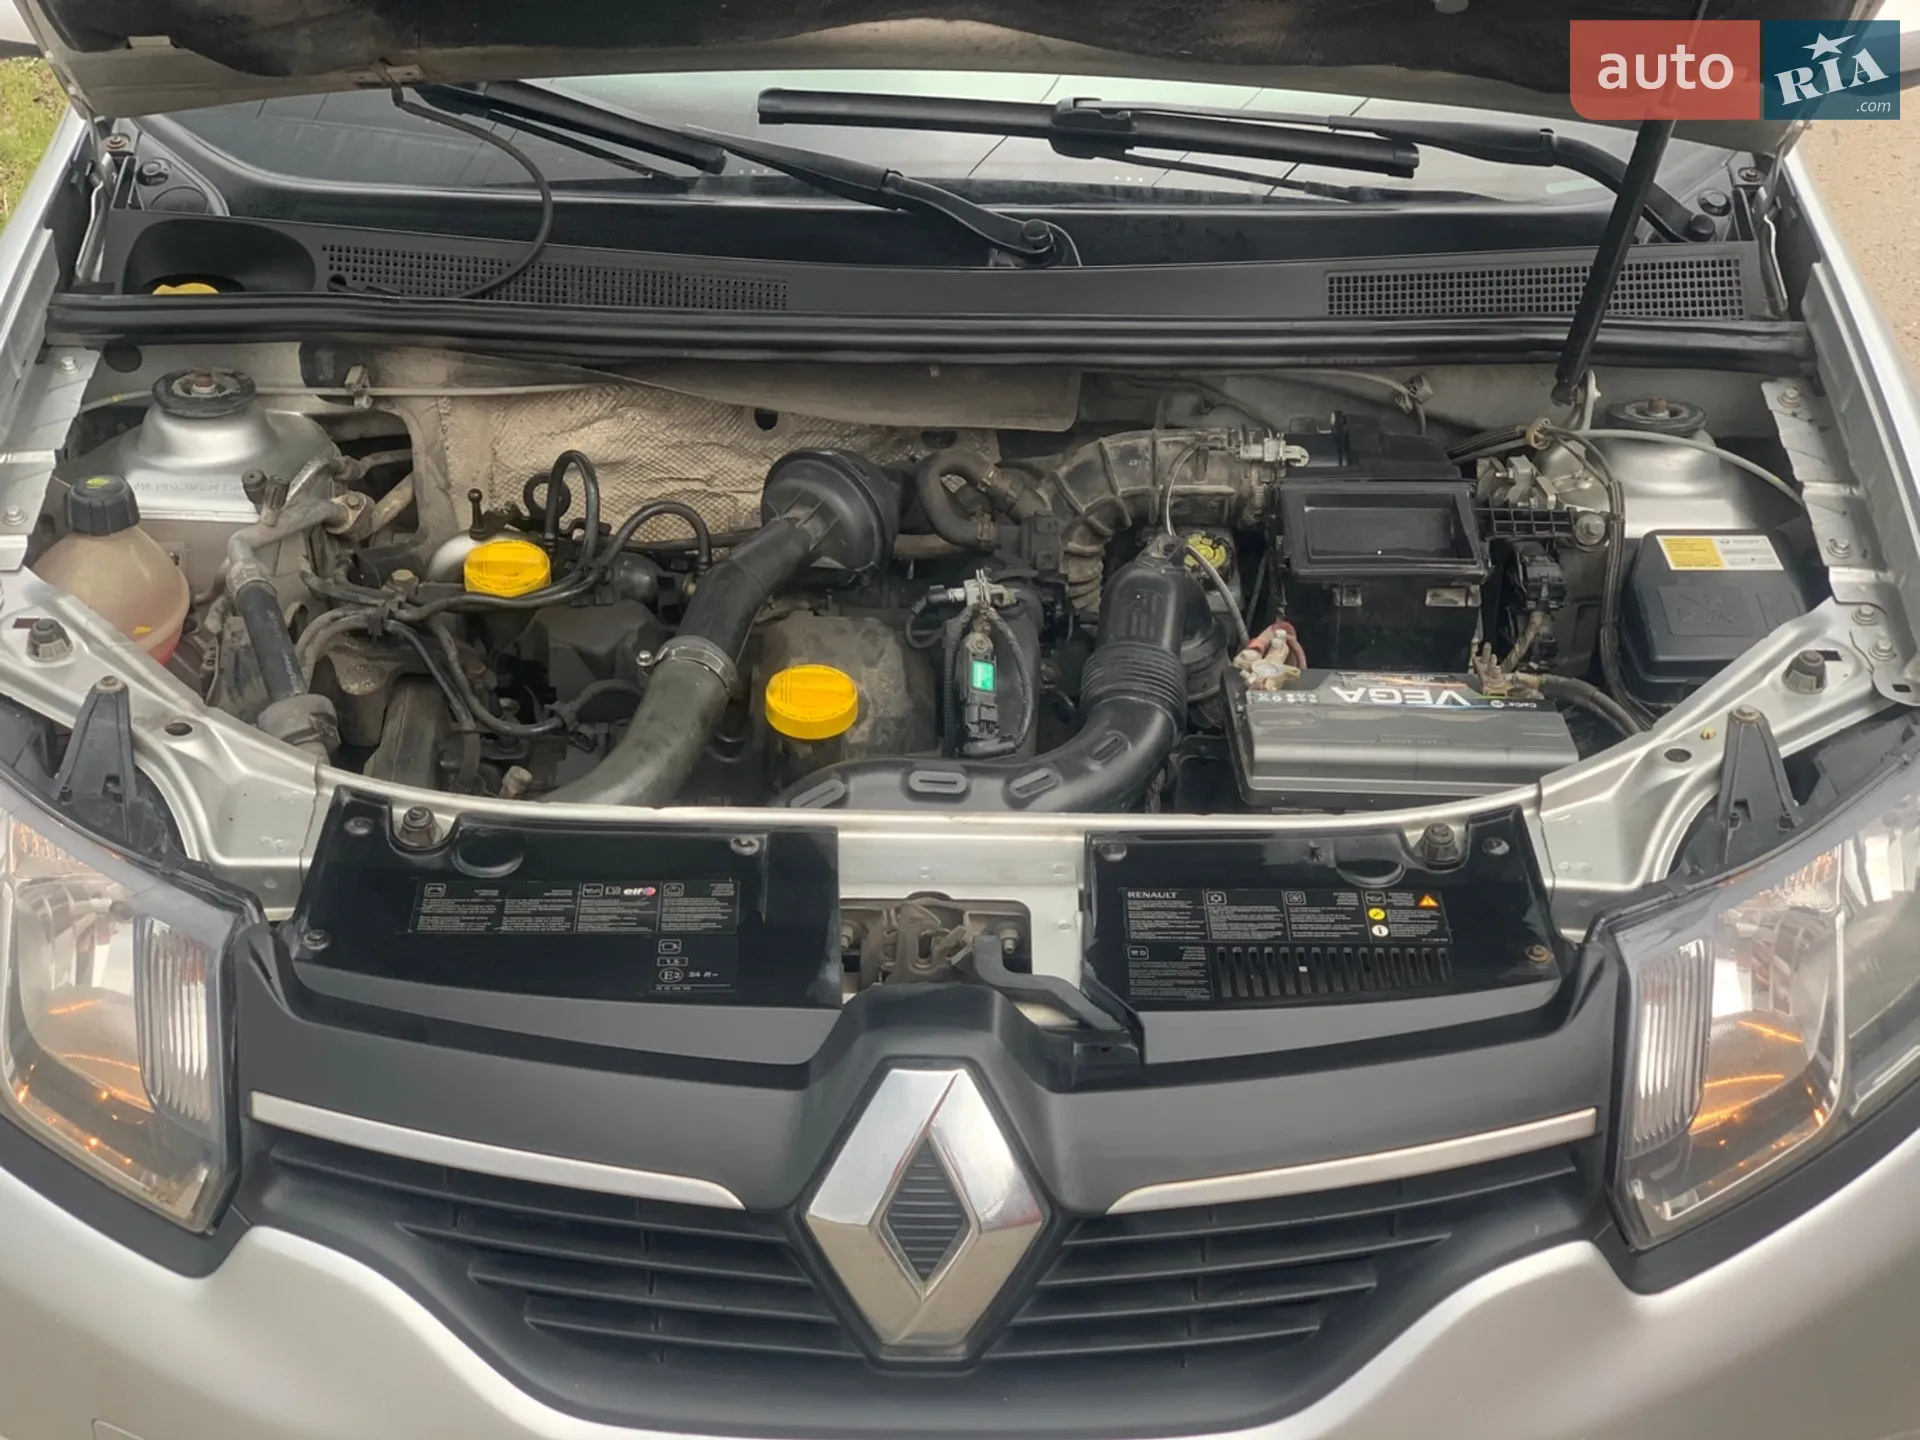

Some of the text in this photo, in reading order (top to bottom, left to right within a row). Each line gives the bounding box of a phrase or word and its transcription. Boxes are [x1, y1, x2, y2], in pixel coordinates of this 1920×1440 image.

[1330, 686, 1471, 706] VEGA
[1127, 891, 1178, 899] RENAULT
[664, 970, 681, 980] E2
